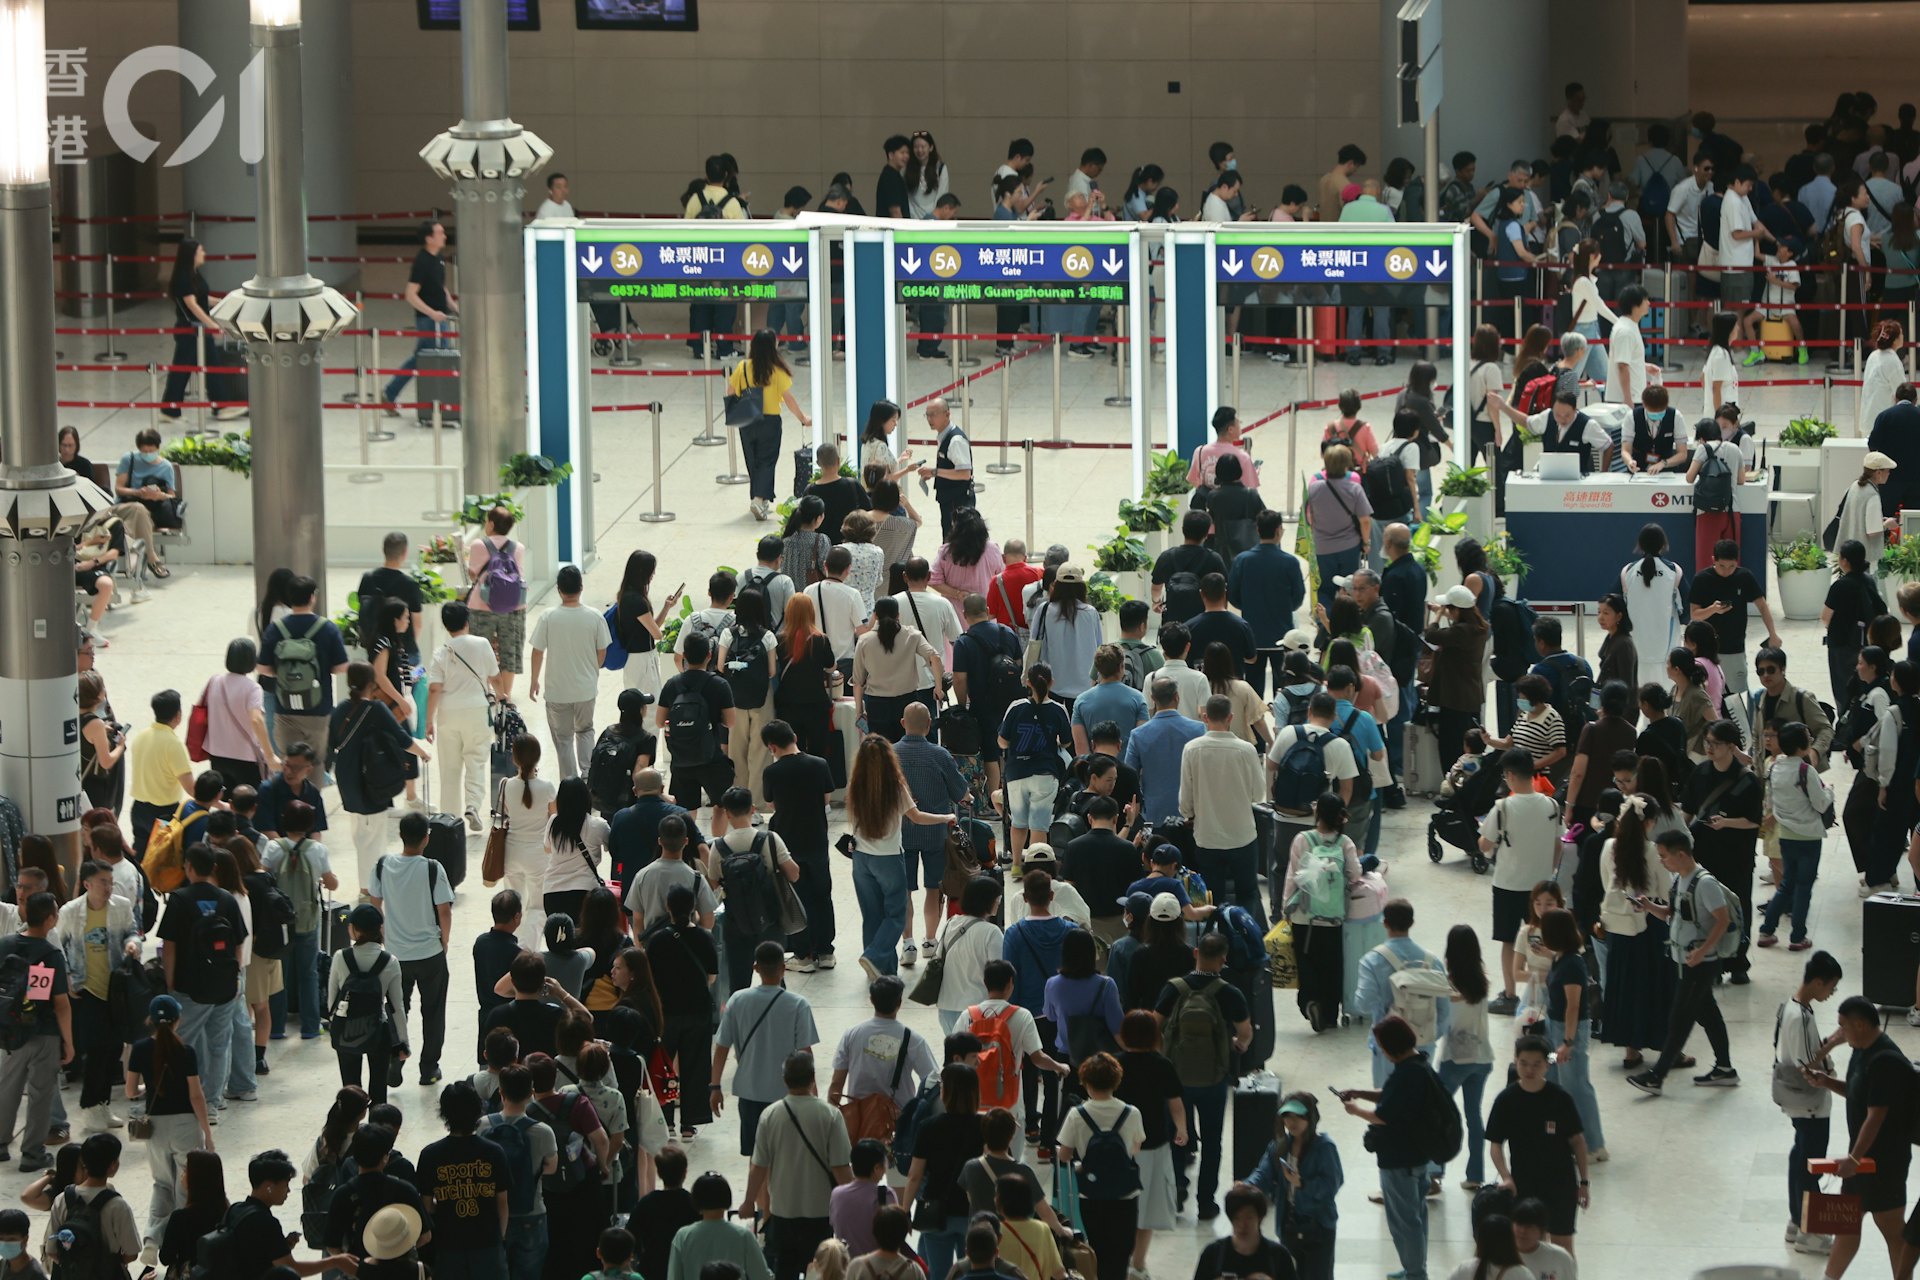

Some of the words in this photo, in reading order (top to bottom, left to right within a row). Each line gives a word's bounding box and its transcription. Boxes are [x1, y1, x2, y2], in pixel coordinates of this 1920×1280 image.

[616, 251, 639, 269] 3A
[659, 246, 725, 264] 檢票閘口
[746, 251, 770, 269] 4A
[934, 252, 957, 271] 5A
[978, 248, 1044, 266] 檢票閘口
[1066, 253, 1090, 271] 6A
[1257, 254, 1280, 272] 7A
[1301, 249, 1368, 267] 檢票閘口
[1389, 254, 1414, 272] 8A
[682, 265, 703, 275] Gate
[1002, 267, 1022, 276] Gate
[1324, 268, 1345, 278] Gate
[679, 284, 729, 298] Shantou
[902, 285, 940, 298] G6540
[984, 285, 1075, 301] Guangzhounan
[1563, 491, 1613, 502] 高速鐵路
[1671, 495, 1694, 505] MT
[29, 974, 50, 989] 20
[436, 1159, 492, 1184] sports
[433, 1178, 497, 1202] archives
[455, 1199, 480, 1217] 08
